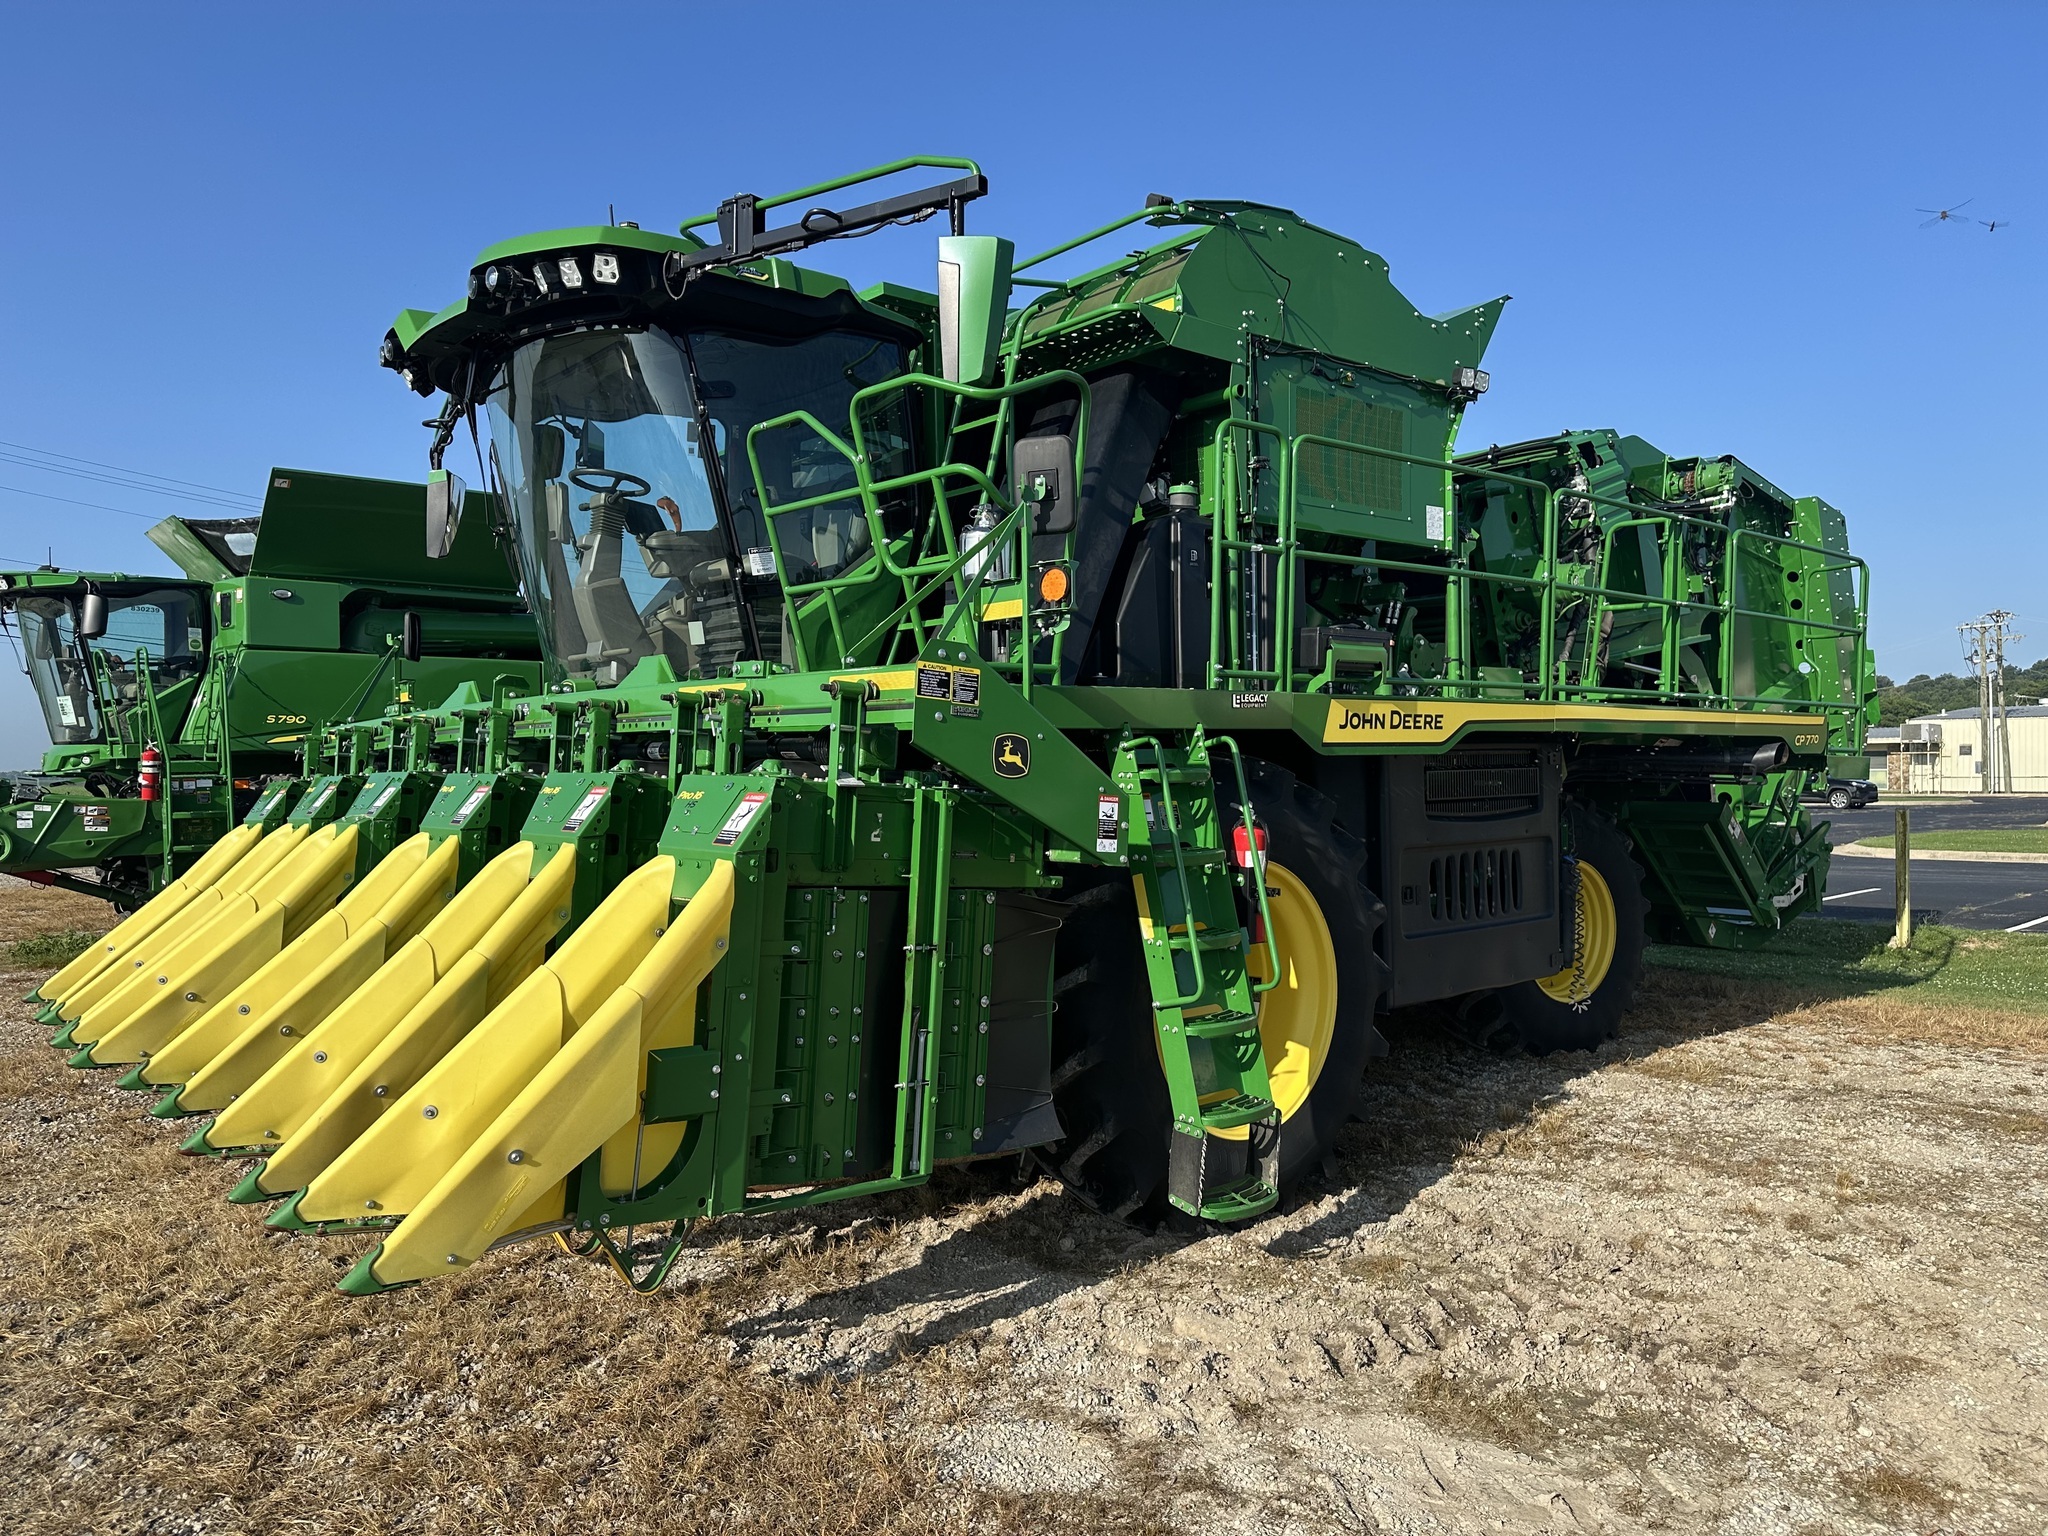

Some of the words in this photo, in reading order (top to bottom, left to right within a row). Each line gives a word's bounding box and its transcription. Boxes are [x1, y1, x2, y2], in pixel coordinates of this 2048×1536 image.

[130, 605, 160, 613] 830239
[927, 663, 947, 671] CAUTION
[1241, 694, 1269, 703] LEGACY
[1338, 709, 1386, 730] JOHN
[1390, 710, 1444, 730] DEERE
[1805, 734, 1820, 746] 770
